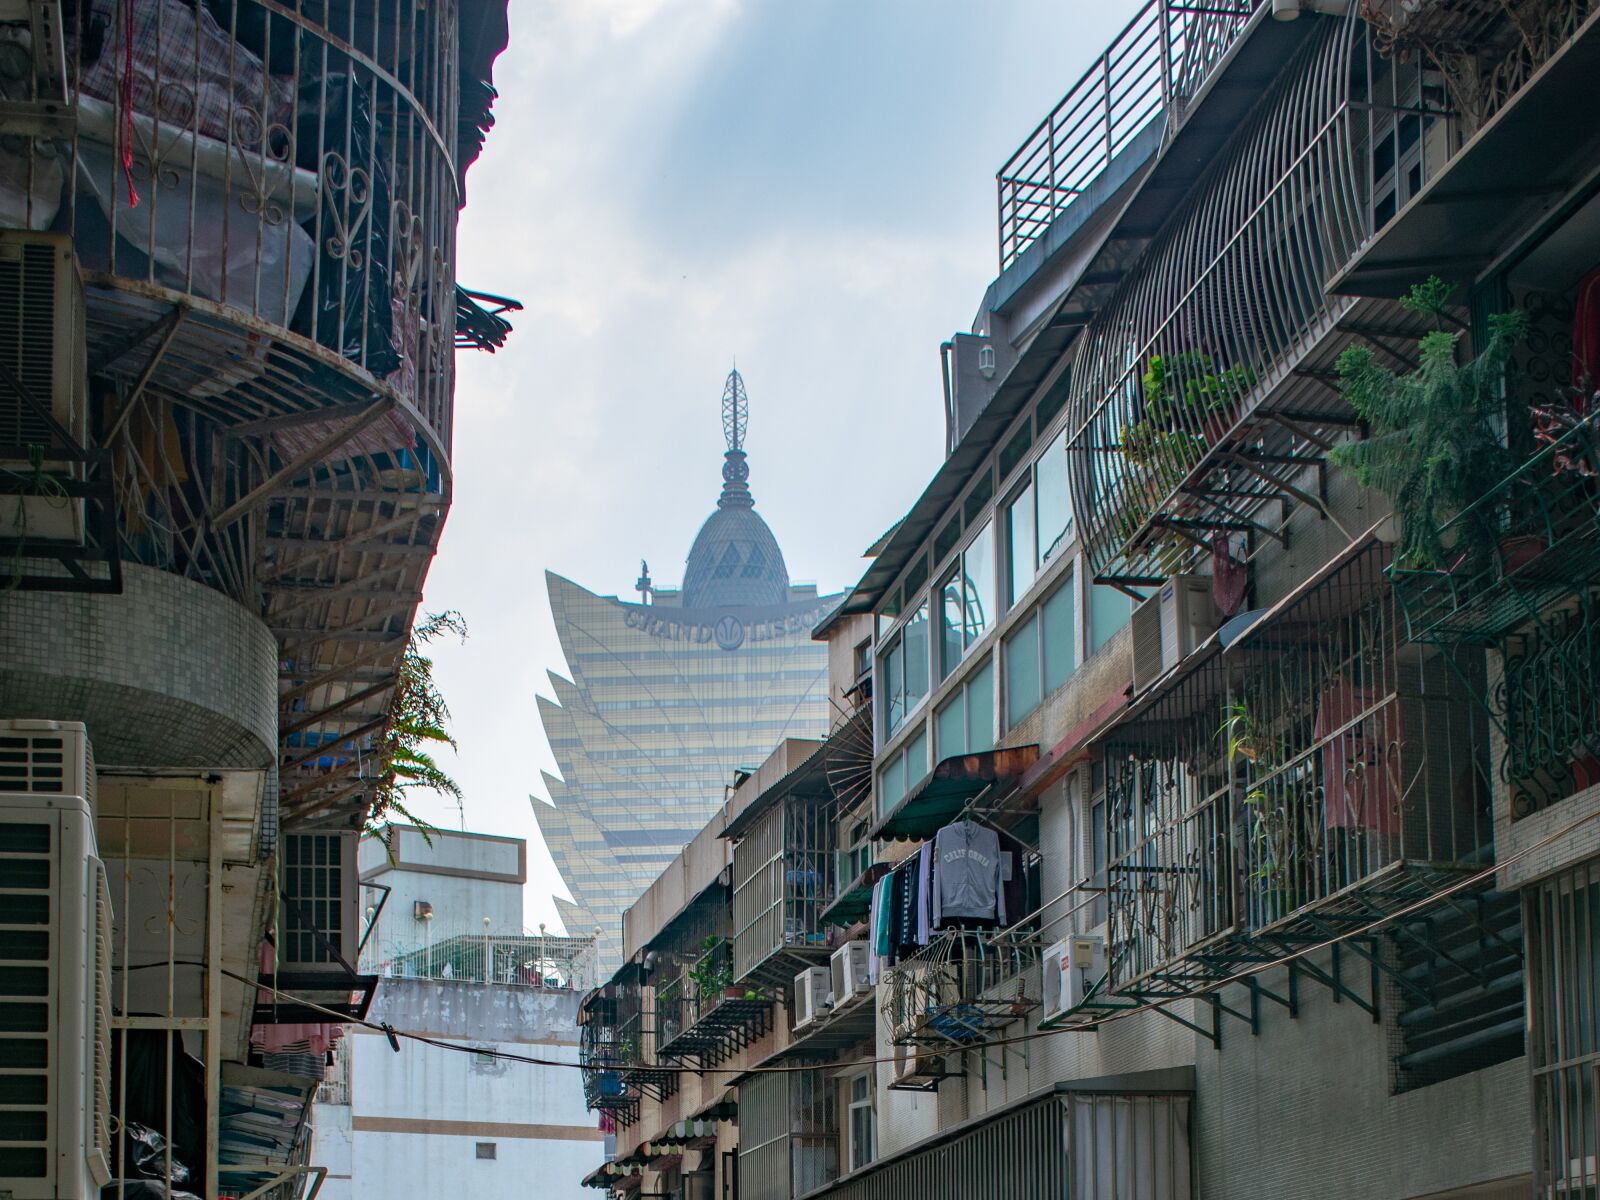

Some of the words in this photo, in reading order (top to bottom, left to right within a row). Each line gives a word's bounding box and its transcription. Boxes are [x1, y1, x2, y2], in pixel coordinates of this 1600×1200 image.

[624, 607, 713, 644] GRAND
[750, 602, 835, 643] LISBOA
[943, 848, 990, 868] CALIFORNIA
